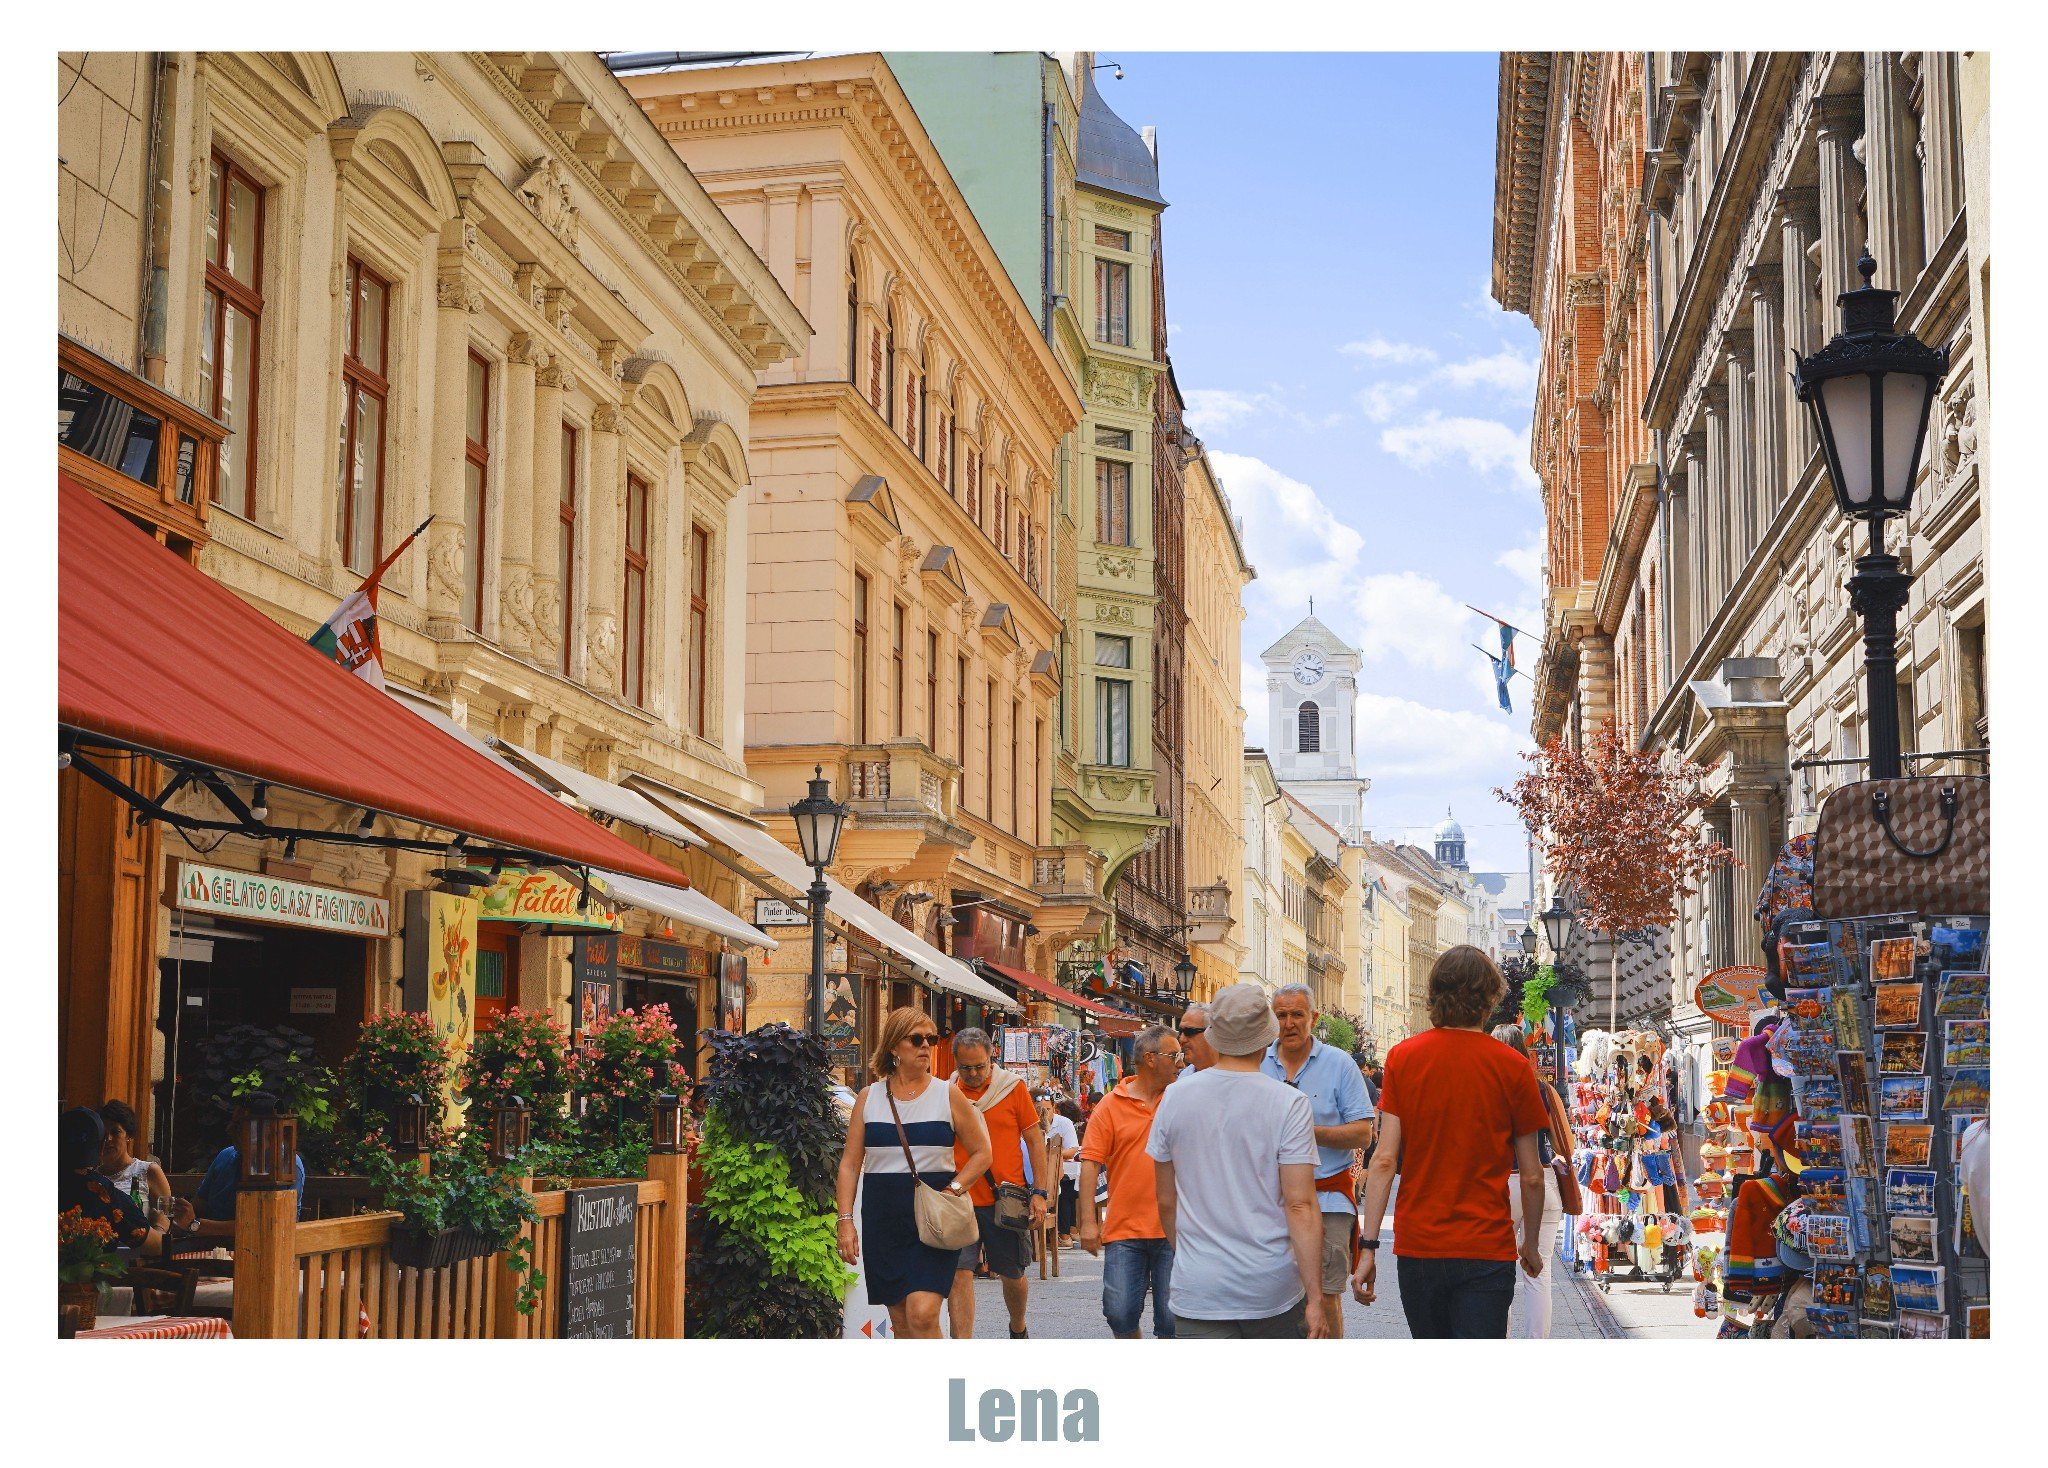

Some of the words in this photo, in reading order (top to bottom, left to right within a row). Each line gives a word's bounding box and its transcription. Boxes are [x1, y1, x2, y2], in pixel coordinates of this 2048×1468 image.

[211, 876, 267, 911] GELATO
[270, 886, 312, 918] OLASZ
[512, 876, 577, 917] Fatál
[1713, 966, 1737, 981] Hand
[577, 1194, 614, 1233] RUSTICO
